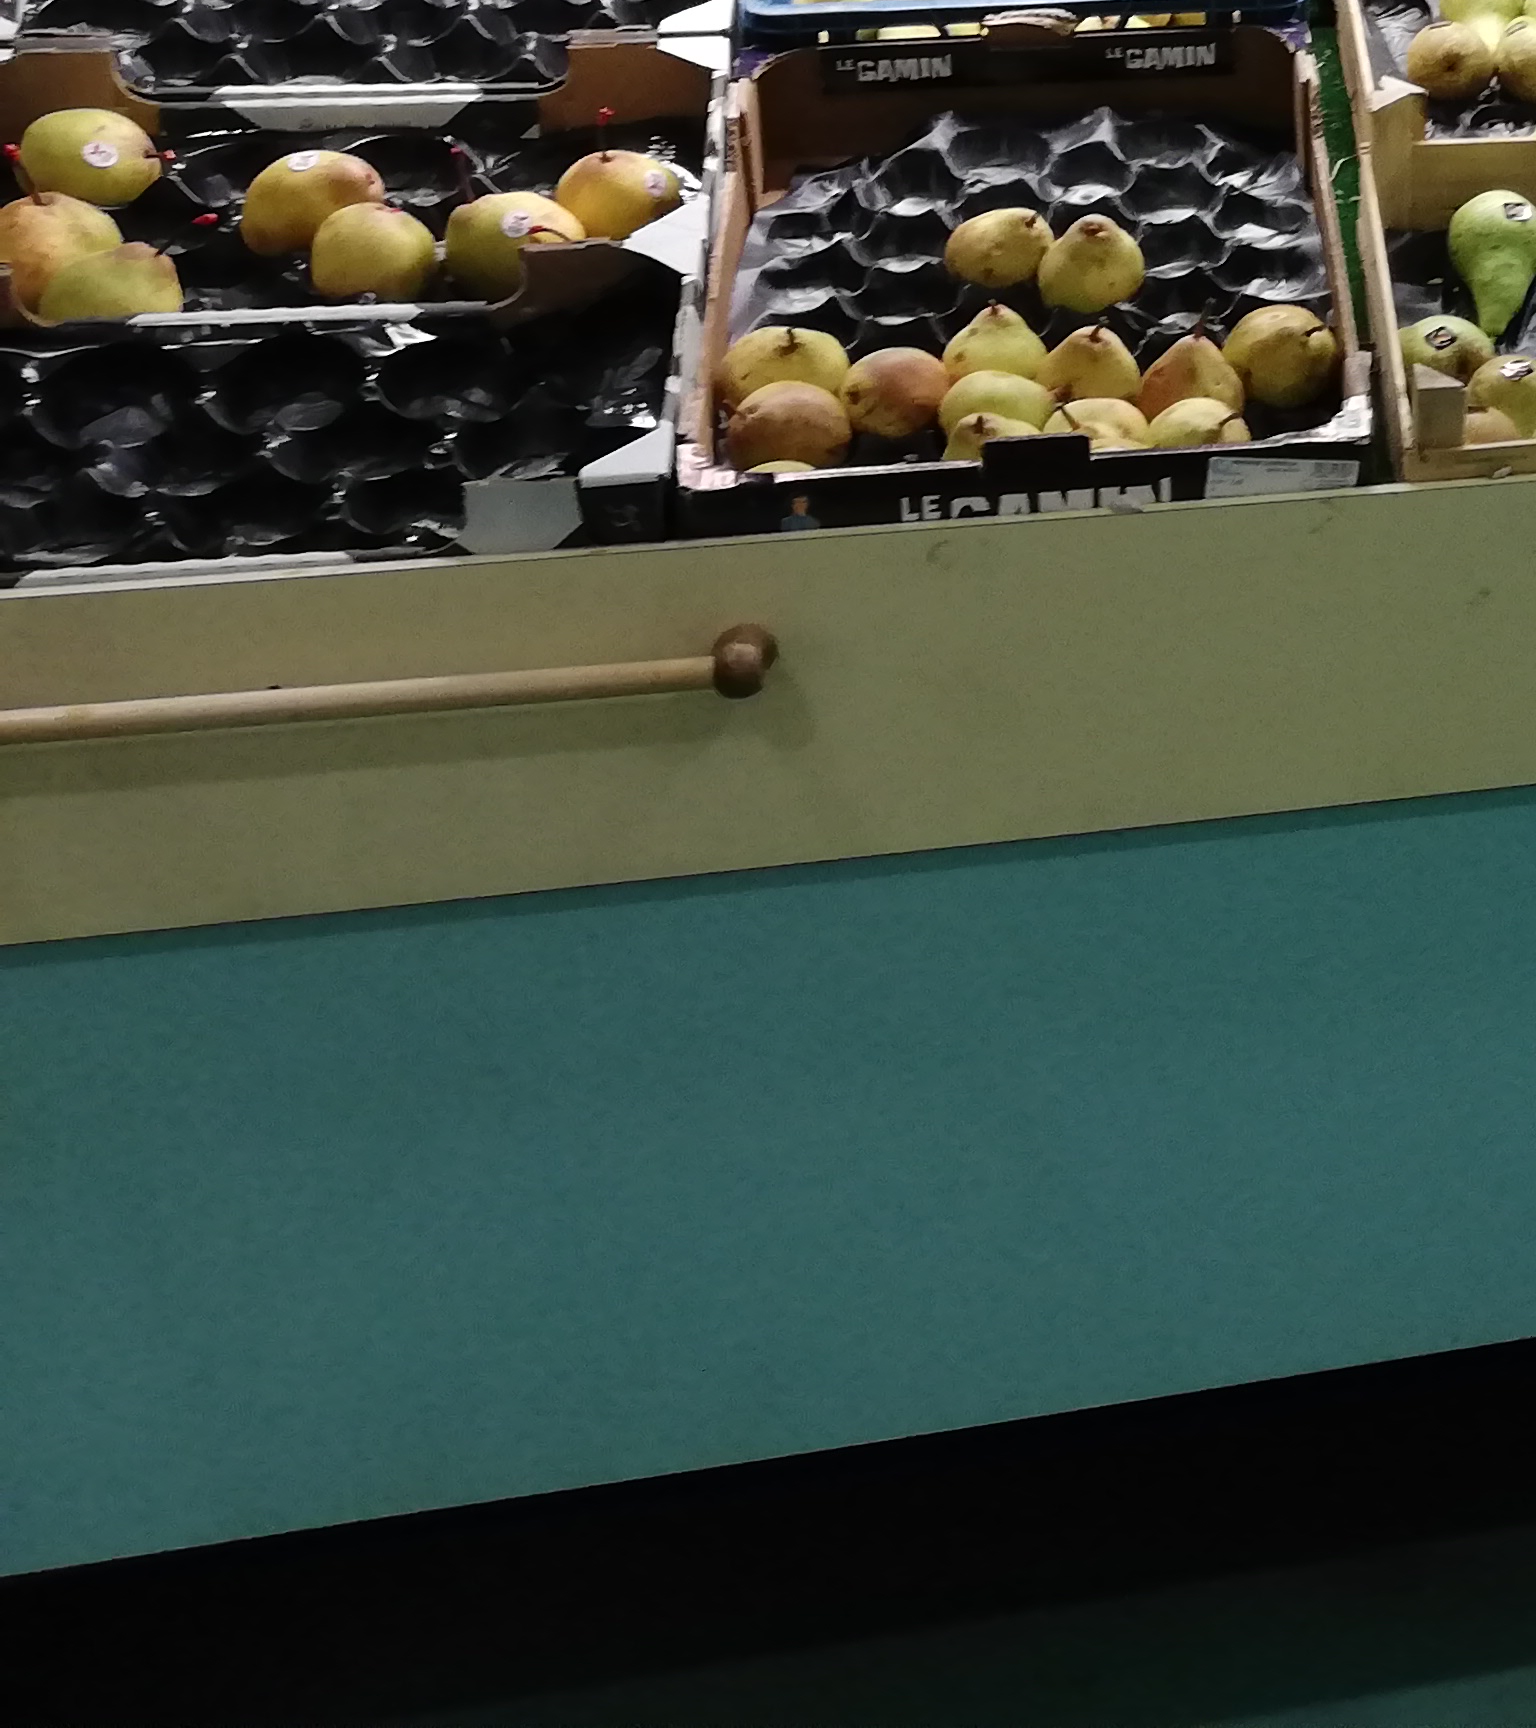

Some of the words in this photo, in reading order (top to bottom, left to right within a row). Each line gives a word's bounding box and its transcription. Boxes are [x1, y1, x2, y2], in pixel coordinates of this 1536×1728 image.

[856, 53, 953, 83] GAMIN
[1125, 42, 1217, 70] GAMIN
[900, 494, 943, 522] LE
